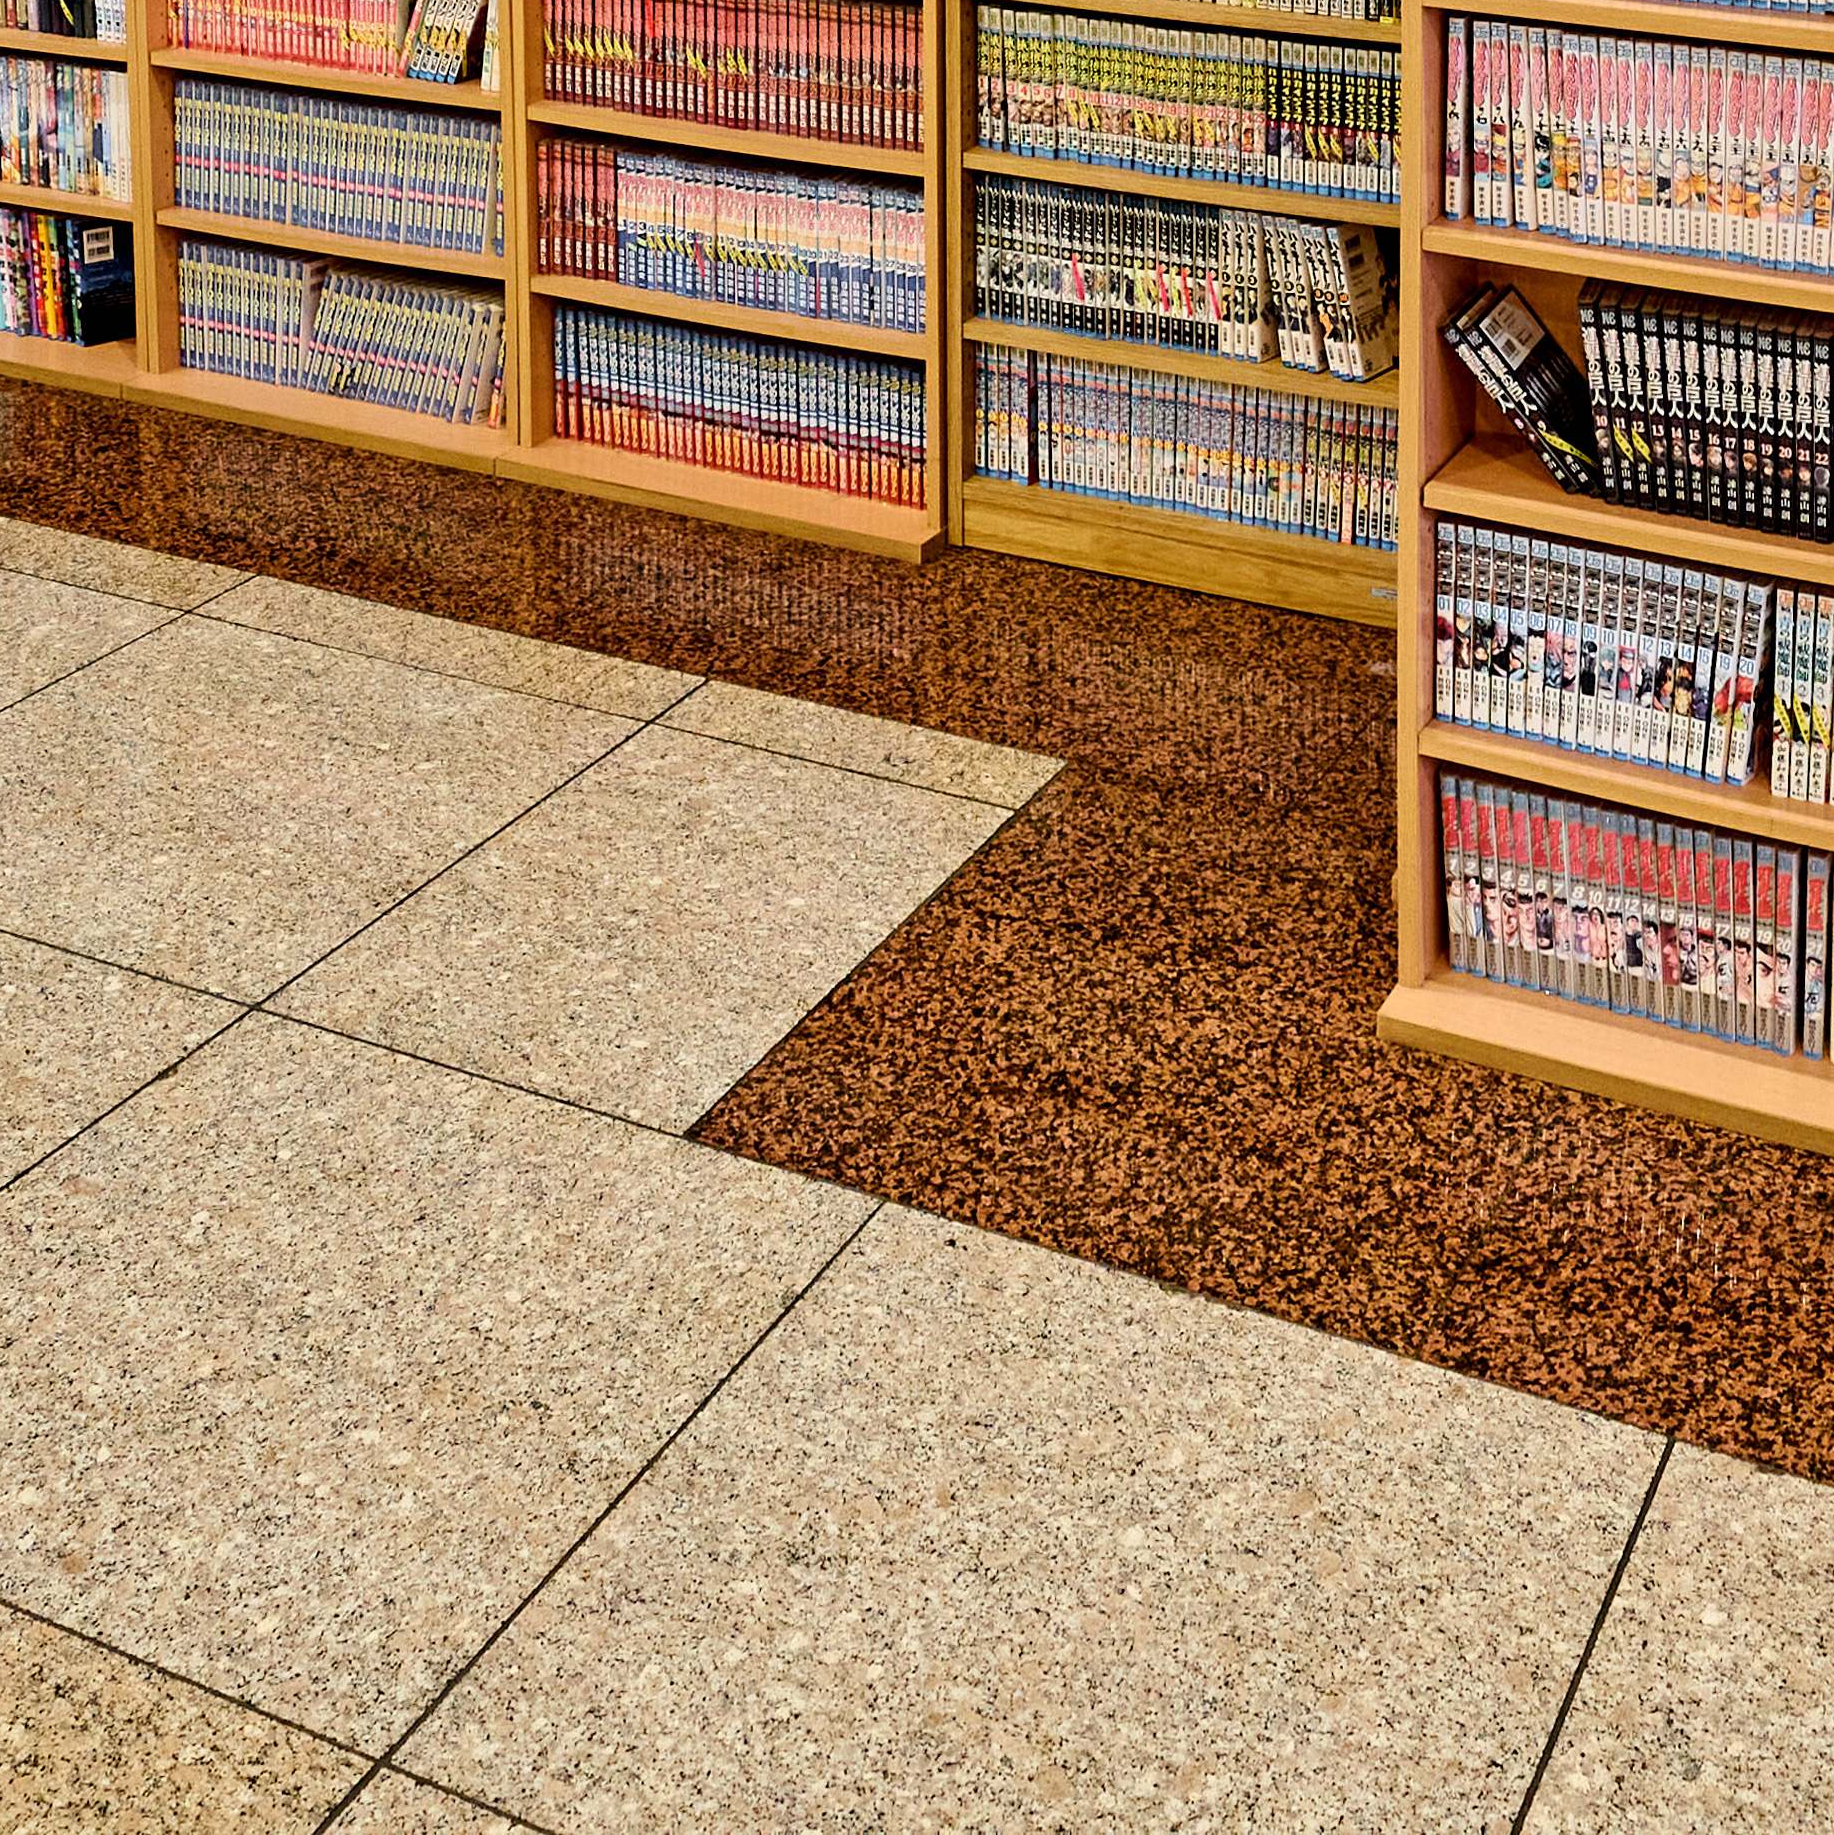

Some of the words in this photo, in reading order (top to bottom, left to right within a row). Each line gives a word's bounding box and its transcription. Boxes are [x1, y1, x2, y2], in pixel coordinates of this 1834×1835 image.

[1595, 416, 1608, 427] 10
[1778, 447, 1792, 459] 20
[1438, 597, 1452, 611] 01
[1529, 613, 1544, 628] 06
